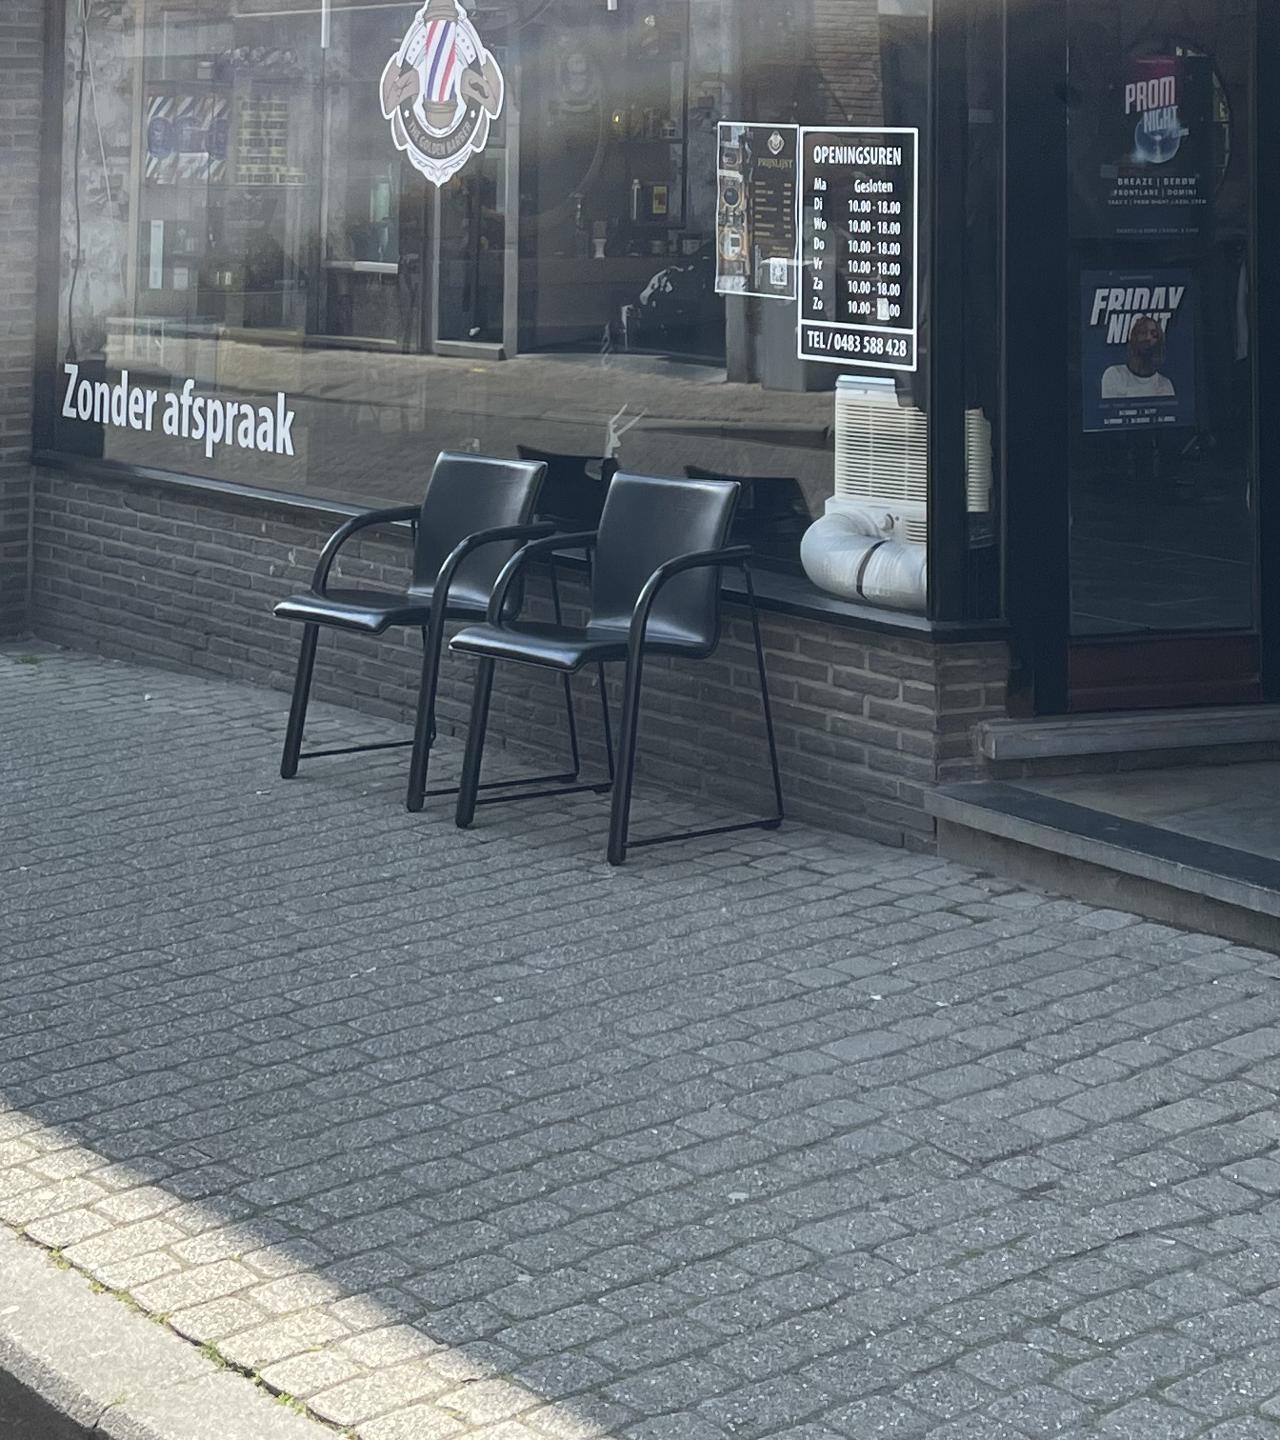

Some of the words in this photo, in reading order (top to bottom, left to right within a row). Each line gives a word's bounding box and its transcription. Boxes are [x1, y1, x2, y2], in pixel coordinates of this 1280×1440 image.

[1125, 75, 1175, 114] PROM
[813, 145, 902, 166] OPENINGSUREN
[813, 177, 827, 191] Ma
[854, 179, 893, 193] Gesloten
[813, 197, 823, 210] Di
[848, 200, 871, 213] 10.00
[877, 200, 901, 214] 18.00
[813, 217, 827, 231] Wo
[848, 220, 871, 233] 10.00
[877, 221, 901, 235] 18.00
[813, 237, 825, 250] Do
[848, 240, 871, 254] 10.00
[877, 241, 901, 255] 18.00
[813, 257, 823, 270] Vr
[848, 260, 871, 274] 10.00
[877, 261, 901, 276] 18.00
[813, 277, 823, 290] Za
[848, 280, 871, 294] 10.00
[877, 282, 901, 296] 18.00
[812, 297, 823, 310] Zo
[848, 301, 871, 314] 10.00
[1090, 286, 1185, 325] FRIDAY
[1106, 312, 1171, 344] NIT
[807, 330, 826, 349] TEL
[834, 333, 861, 352] 0483
[863, 336, 884, 354] 588
[885, 339, 907, 357] 428
[62, 363, 157, 432] Zonder
[162, 378, 295, 458] afspraak
